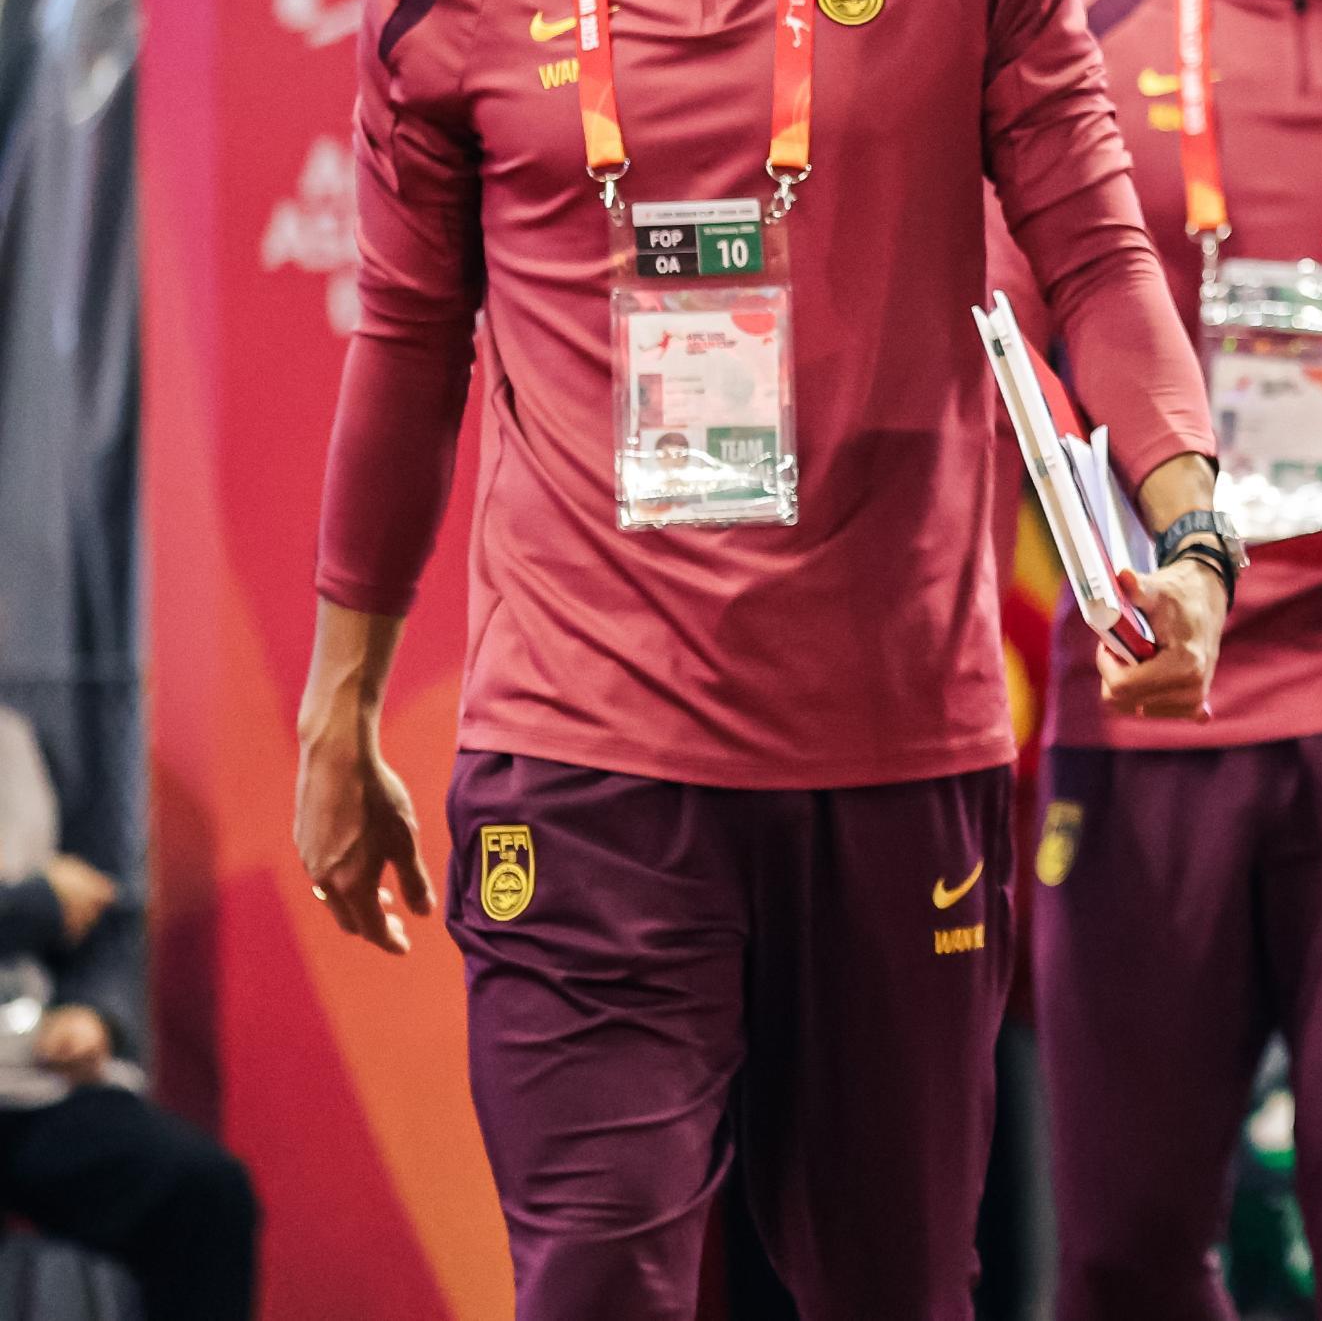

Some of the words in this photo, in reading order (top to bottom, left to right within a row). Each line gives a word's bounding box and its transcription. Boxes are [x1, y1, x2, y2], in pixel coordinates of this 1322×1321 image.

[649, 229, 684, 248] FOP
[716, 238, 749, 268] 10
[655, 255, 681, 274] OA
[487, 833, 528, 853] CFA
